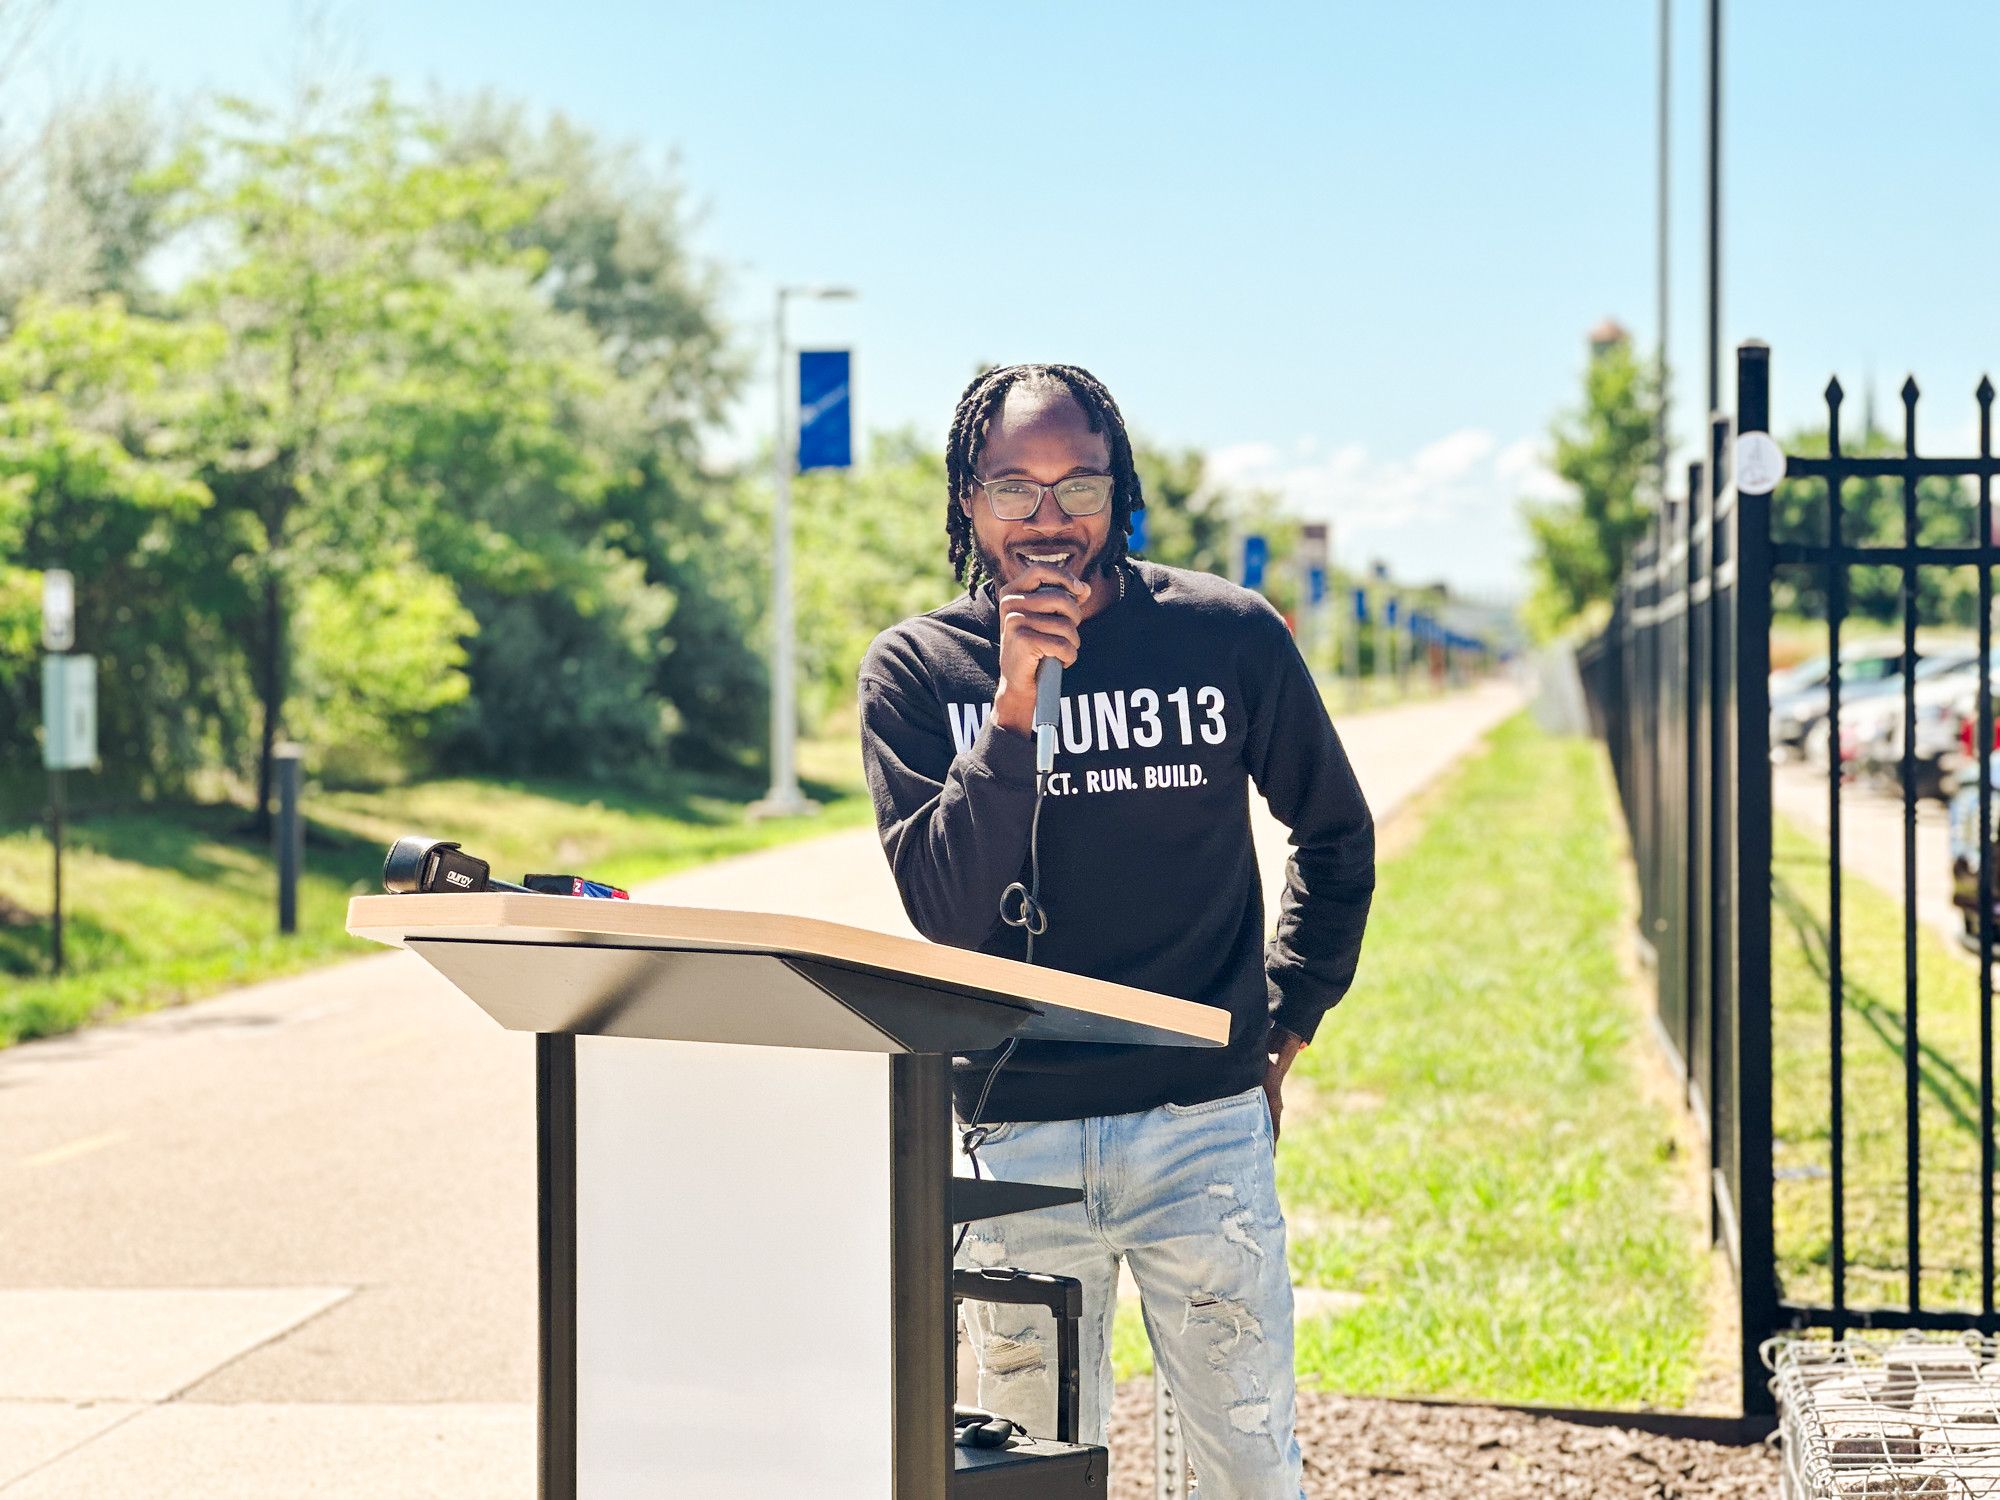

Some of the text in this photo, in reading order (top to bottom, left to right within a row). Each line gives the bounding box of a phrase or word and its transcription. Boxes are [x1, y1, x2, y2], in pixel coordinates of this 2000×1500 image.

[947, 686, 1227, 754] WUN313
[1086, 767, 1138, 793] RUN.
[1144, 764, 1208, 789] BUILD.
